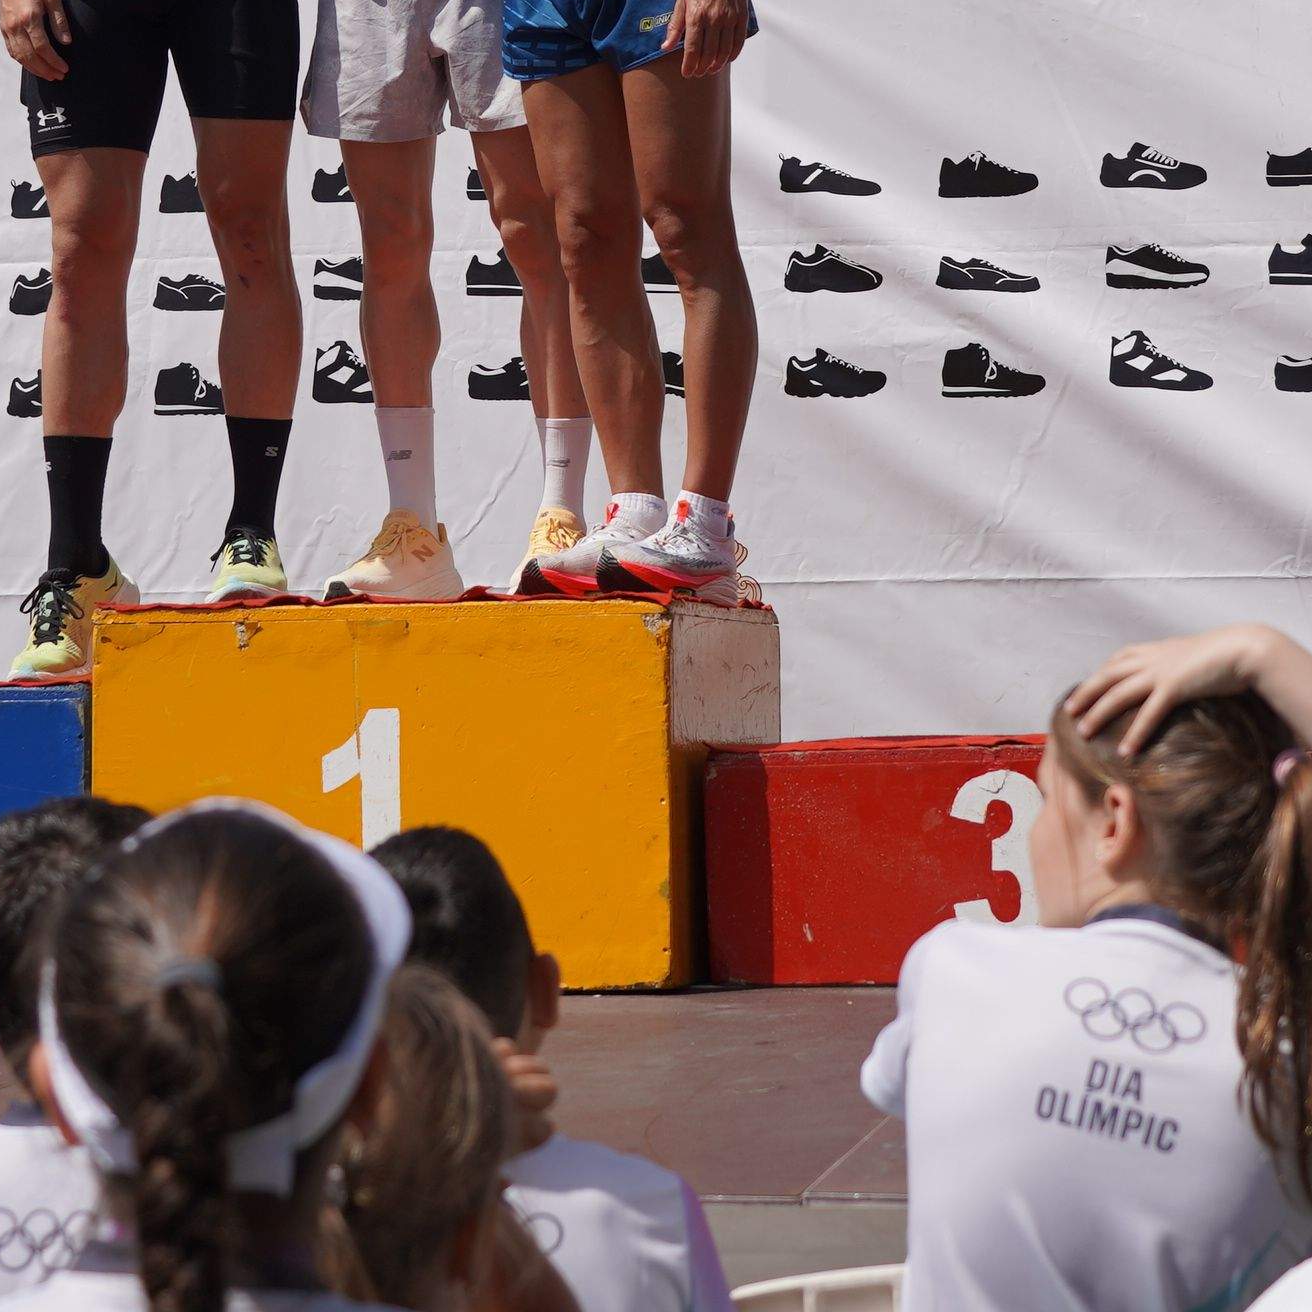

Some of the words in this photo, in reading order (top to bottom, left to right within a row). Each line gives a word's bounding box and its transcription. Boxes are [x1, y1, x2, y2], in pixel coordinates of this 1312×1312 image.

[322, 708, 400, 852] 1
[950, 769, 1044, 926] 3
[1086, 1059, 1143, 1102] DIA
